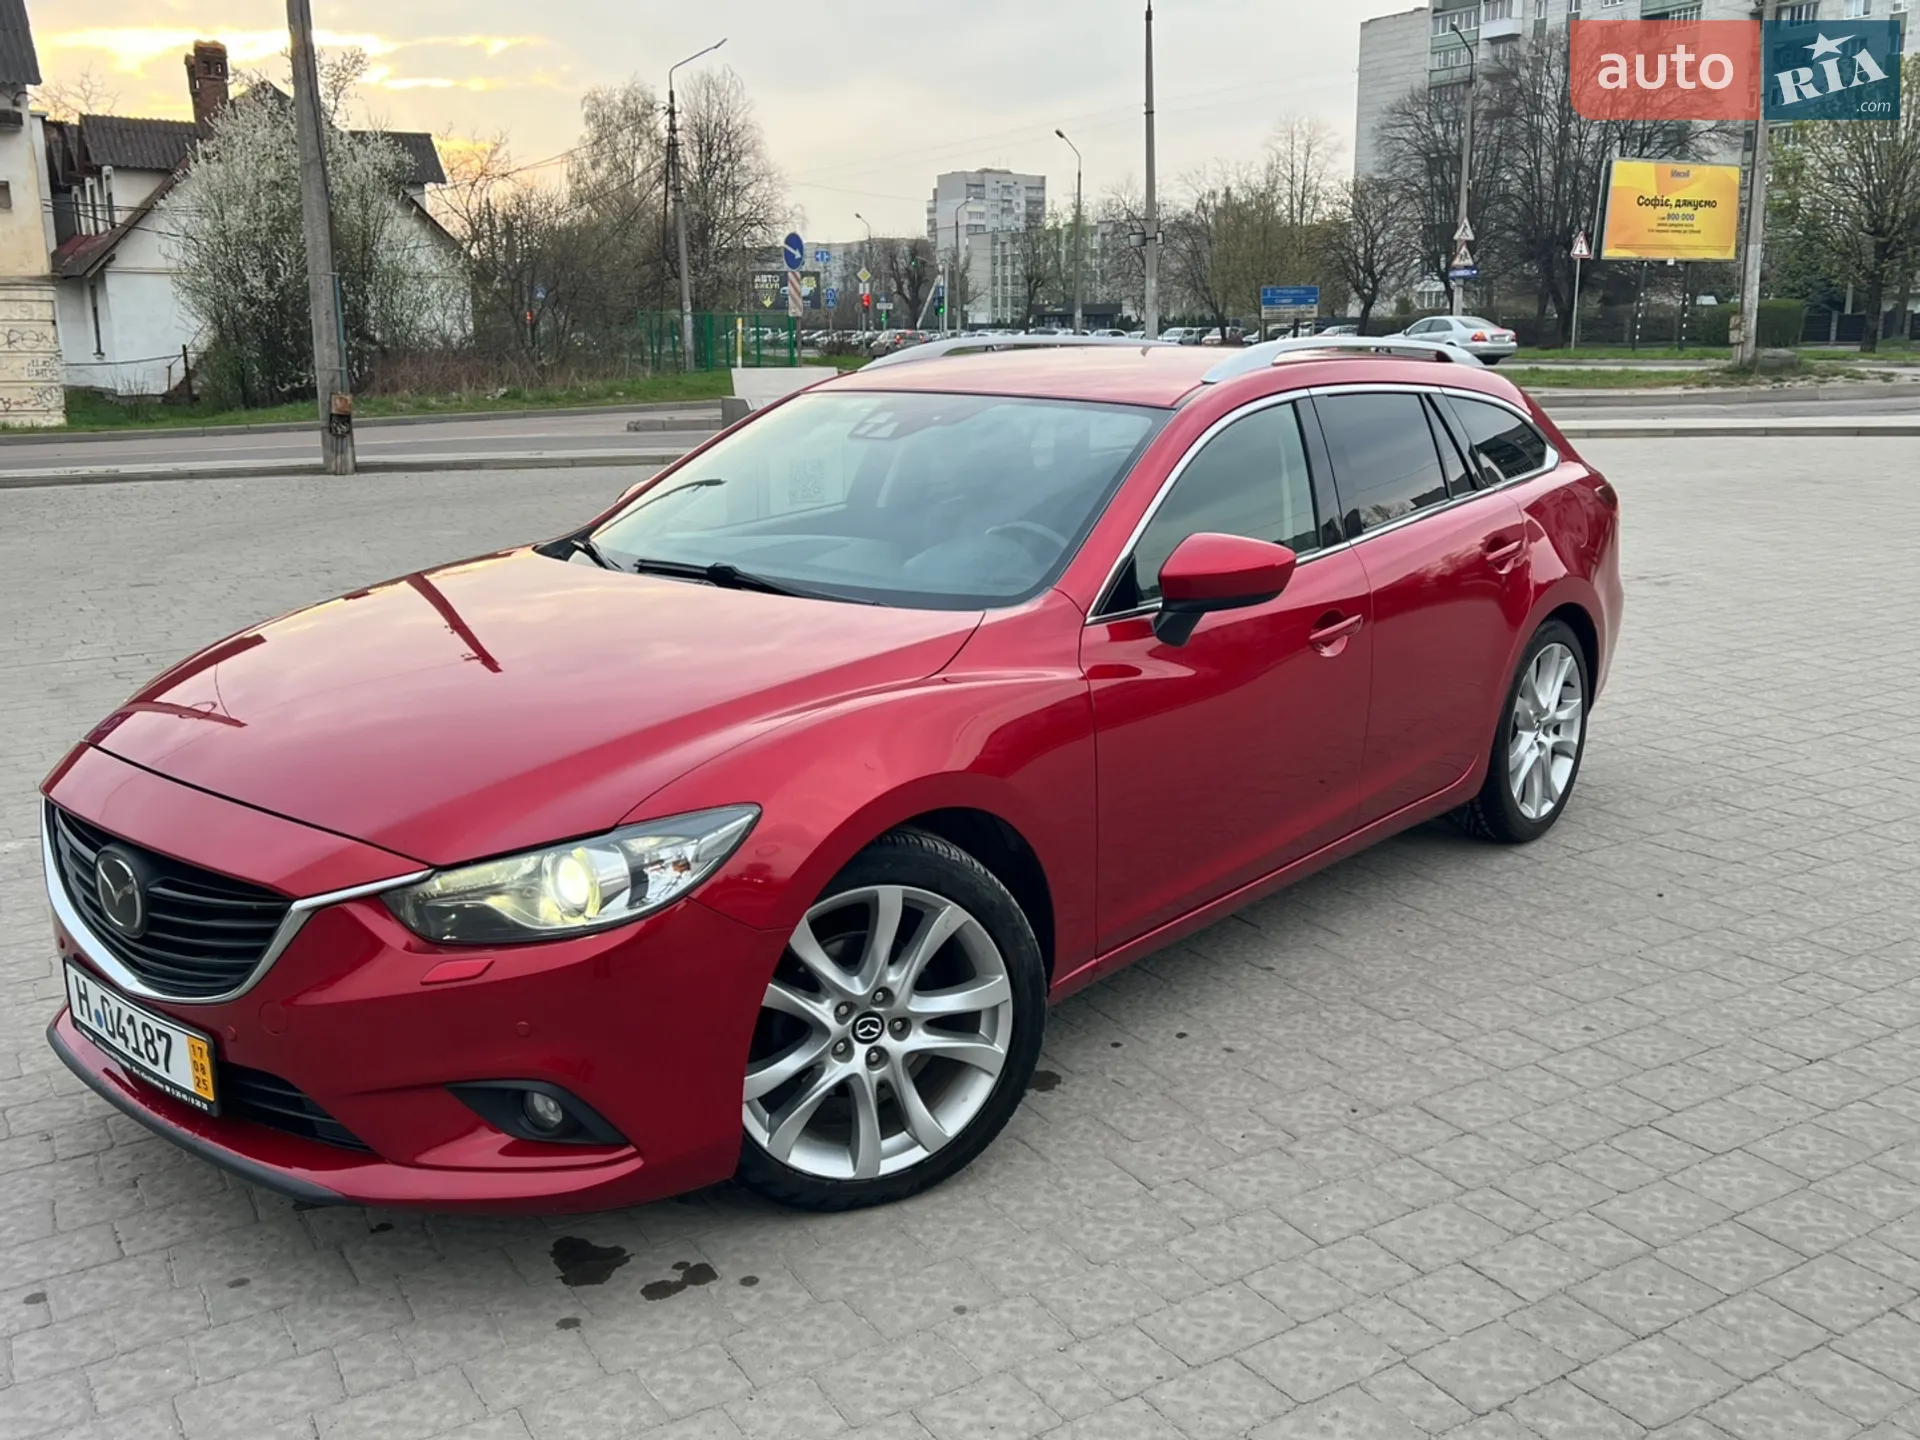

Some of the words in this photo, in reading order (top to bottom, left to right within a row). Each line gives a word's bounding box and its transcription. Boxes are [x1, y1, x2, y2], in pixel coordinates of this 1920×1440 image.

[1637, 195, 1673, 209] Софіє,
[1674, 198, 1718, 211] дякуємо
[754, 275, 780, 283] АВТО
[74, 975, 93, 1022] H
[100, 994, 172, 1074] 04187
[190, 1044, 204, 1058] 17
[193, 1060, 207, 1077] 08
[195, 1076, 209, 1092] 25
